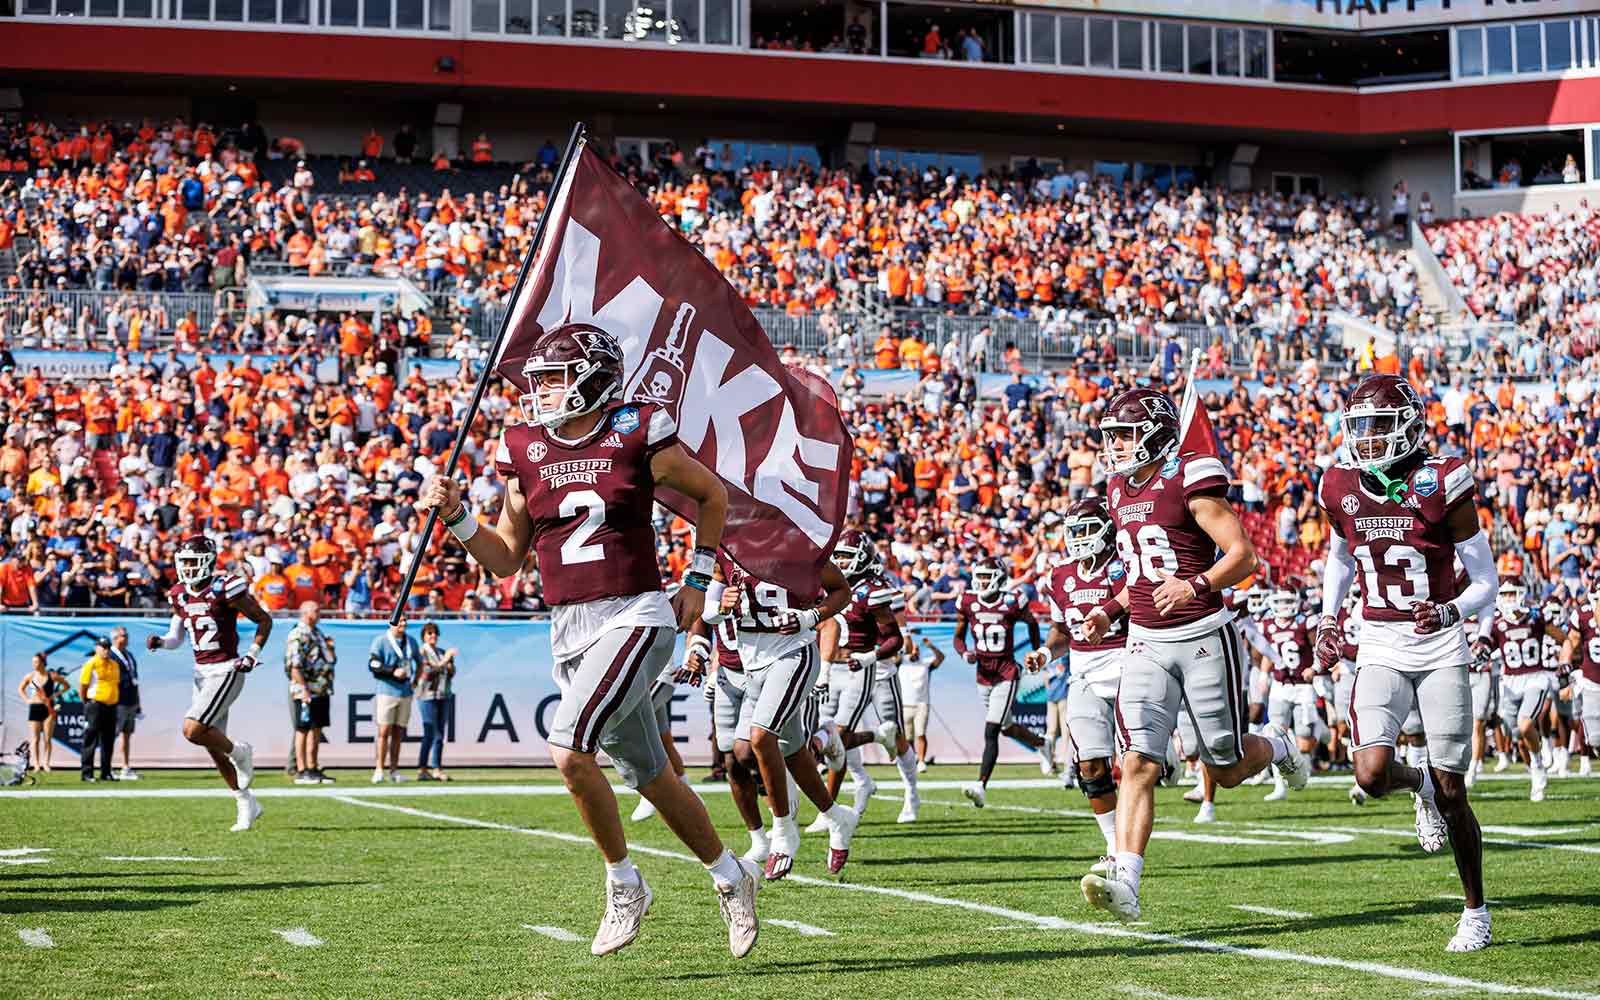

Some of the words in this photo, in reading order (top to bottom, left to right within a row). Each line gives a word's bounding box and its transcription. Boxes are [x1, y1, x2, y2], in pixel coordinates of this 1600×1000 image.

[17, 362, 104, 375] REIAQUEST
[527, 442, 547, 461] SEC
[600, 440, 624, 449] adidas
[539, 460, 613, 478] MISSISSIPPI
[556, 474, 591, 486] STATE
[1342, 496, 1360, 514] SEC
[559, 489, 606, 565] 2
[1355, 519, 1414, 529] MISSISSIPPI
[1371, 529, 1399, 539] STATE
[1353, 545, 1430, 611] 13
[184, 616, 220, 651] 12
[973, 623, 1007, 652] 10
[1503, 637, 1540, 669] 80
